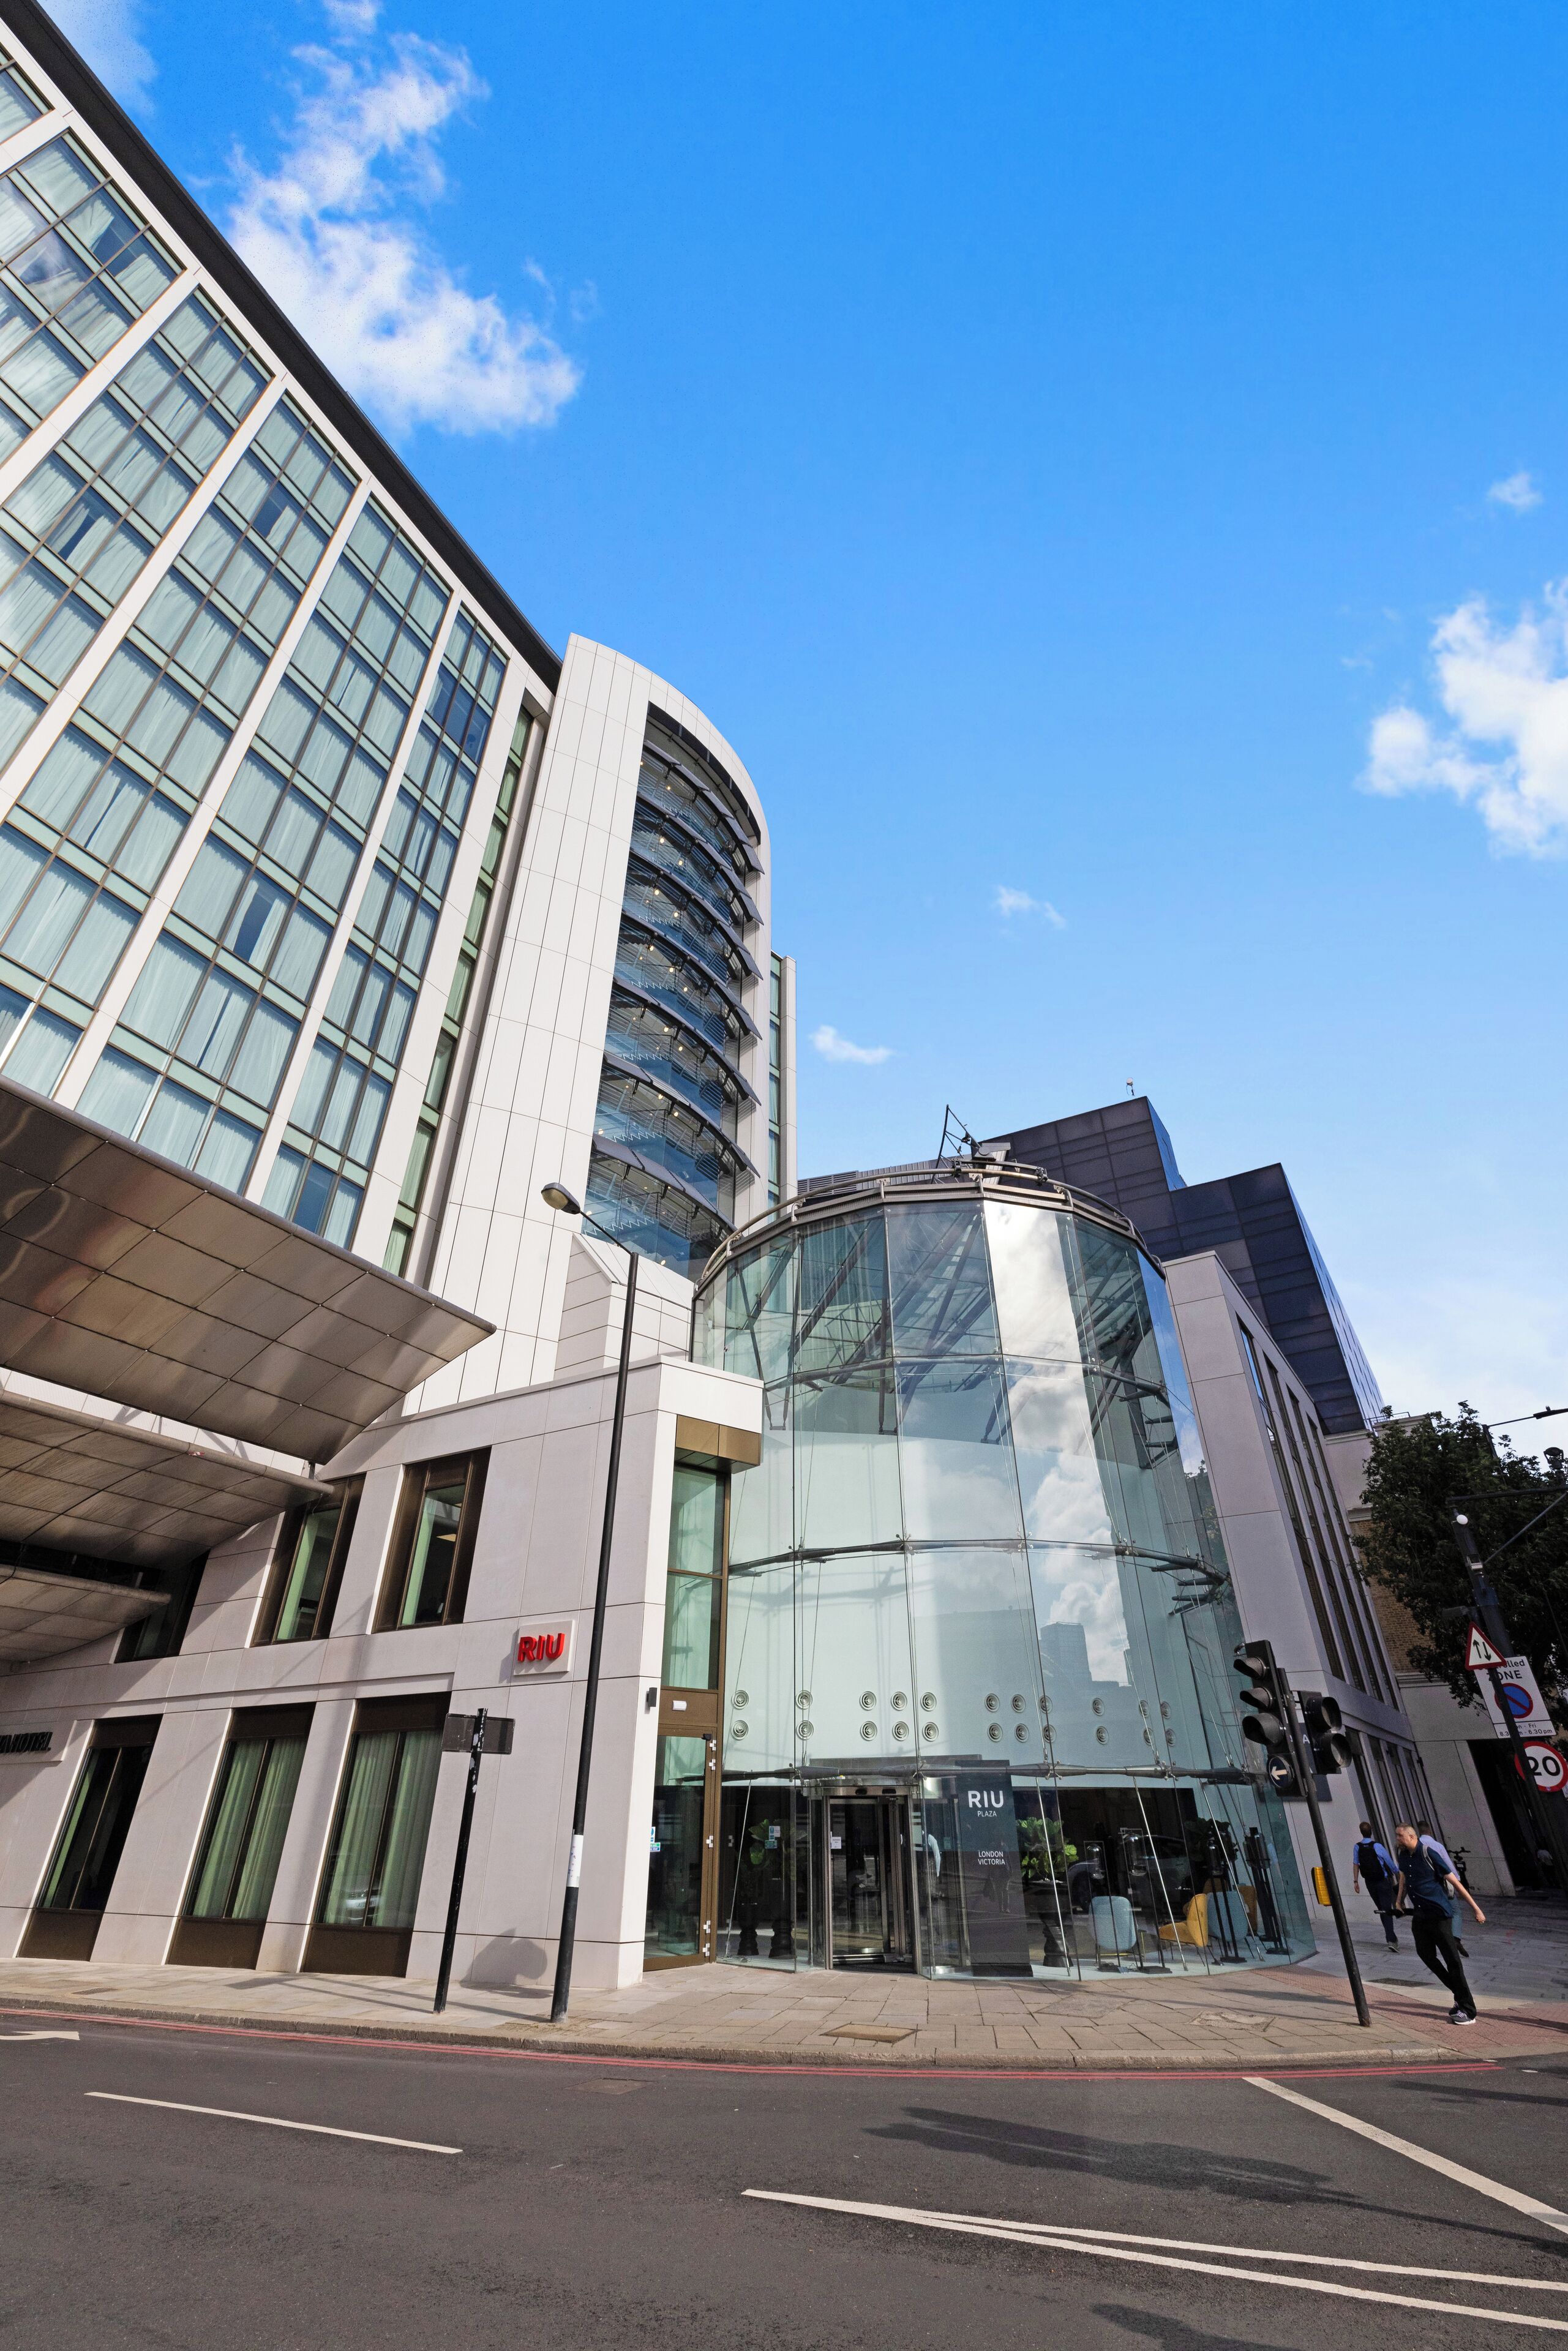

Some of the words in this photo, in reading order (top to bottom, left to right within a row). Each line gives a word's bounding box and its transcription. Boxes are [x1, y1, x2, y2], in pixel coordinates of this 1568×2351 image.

[517, 1633, 565, 1662] RIU
[1527, 1756, 1561, 1777] 20
[968, 1790, 1003, 1808] RIU
